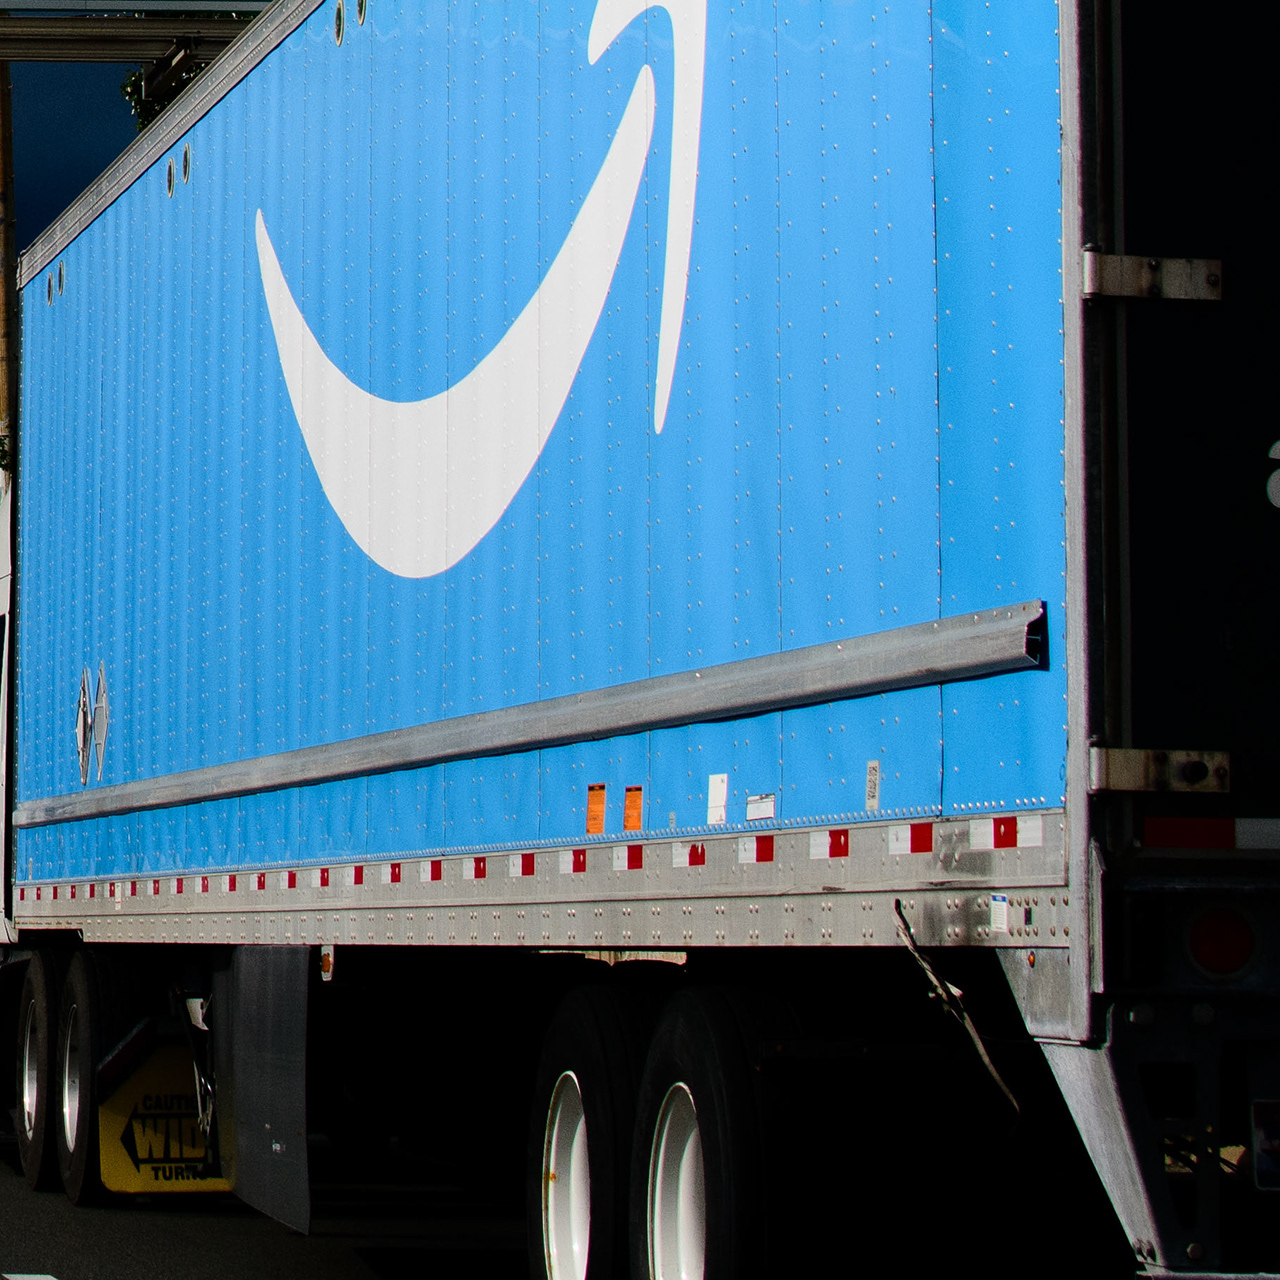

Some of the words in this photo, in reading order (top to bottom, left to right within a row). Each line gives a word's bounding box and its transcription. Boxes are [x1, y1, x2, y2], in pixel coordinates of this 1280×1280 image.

[143, 1095, 198, 1111] CAUTI
[131, 1117, 207, 1160] WID
[152, 1166, 201, 1181] TUR
